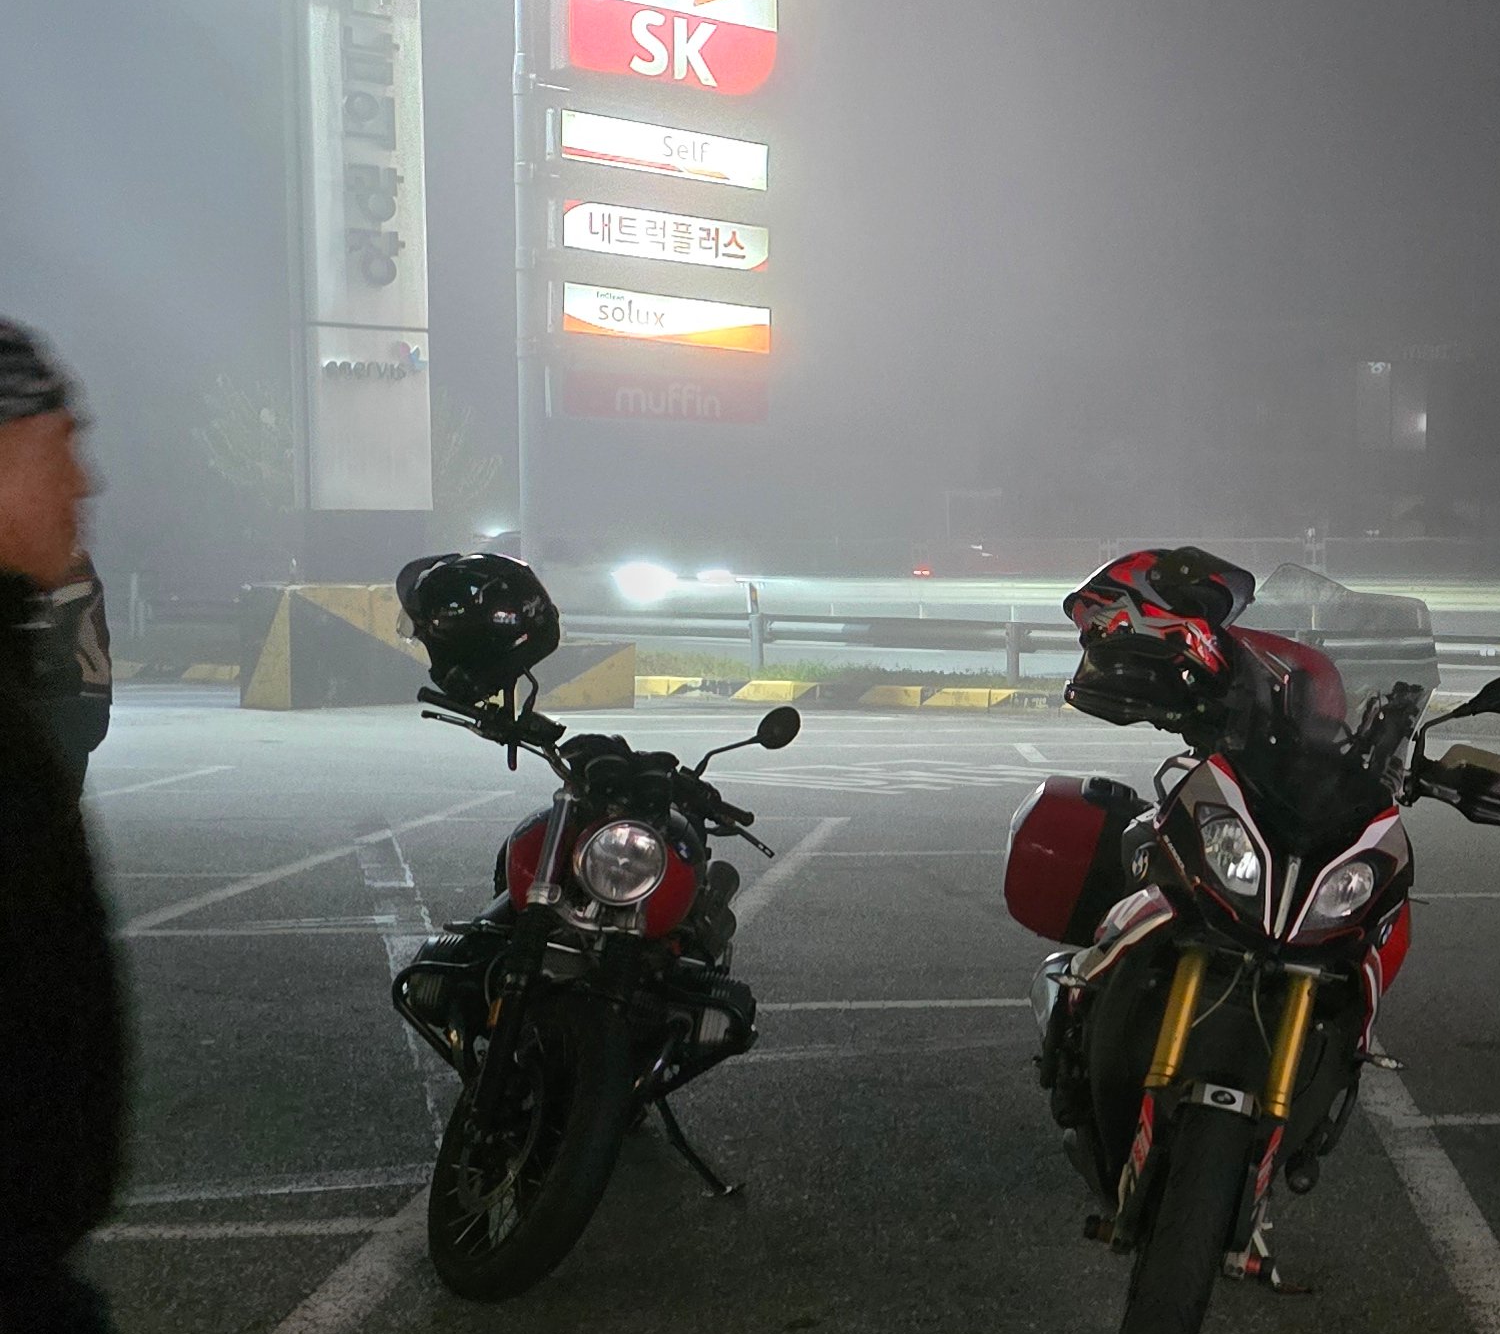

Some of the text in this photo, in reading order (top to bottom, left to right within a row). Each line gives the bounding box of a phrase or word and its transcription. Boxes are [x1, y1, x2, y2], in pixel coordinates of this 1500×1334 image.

[629, 9, 718, 87] SK
[663, 135, 710, 163] Self
[589, 212, 746, 259] 내트럭플러스
[598, 299, 665, 328] solux
[615, 382, 721, 418] muffin
